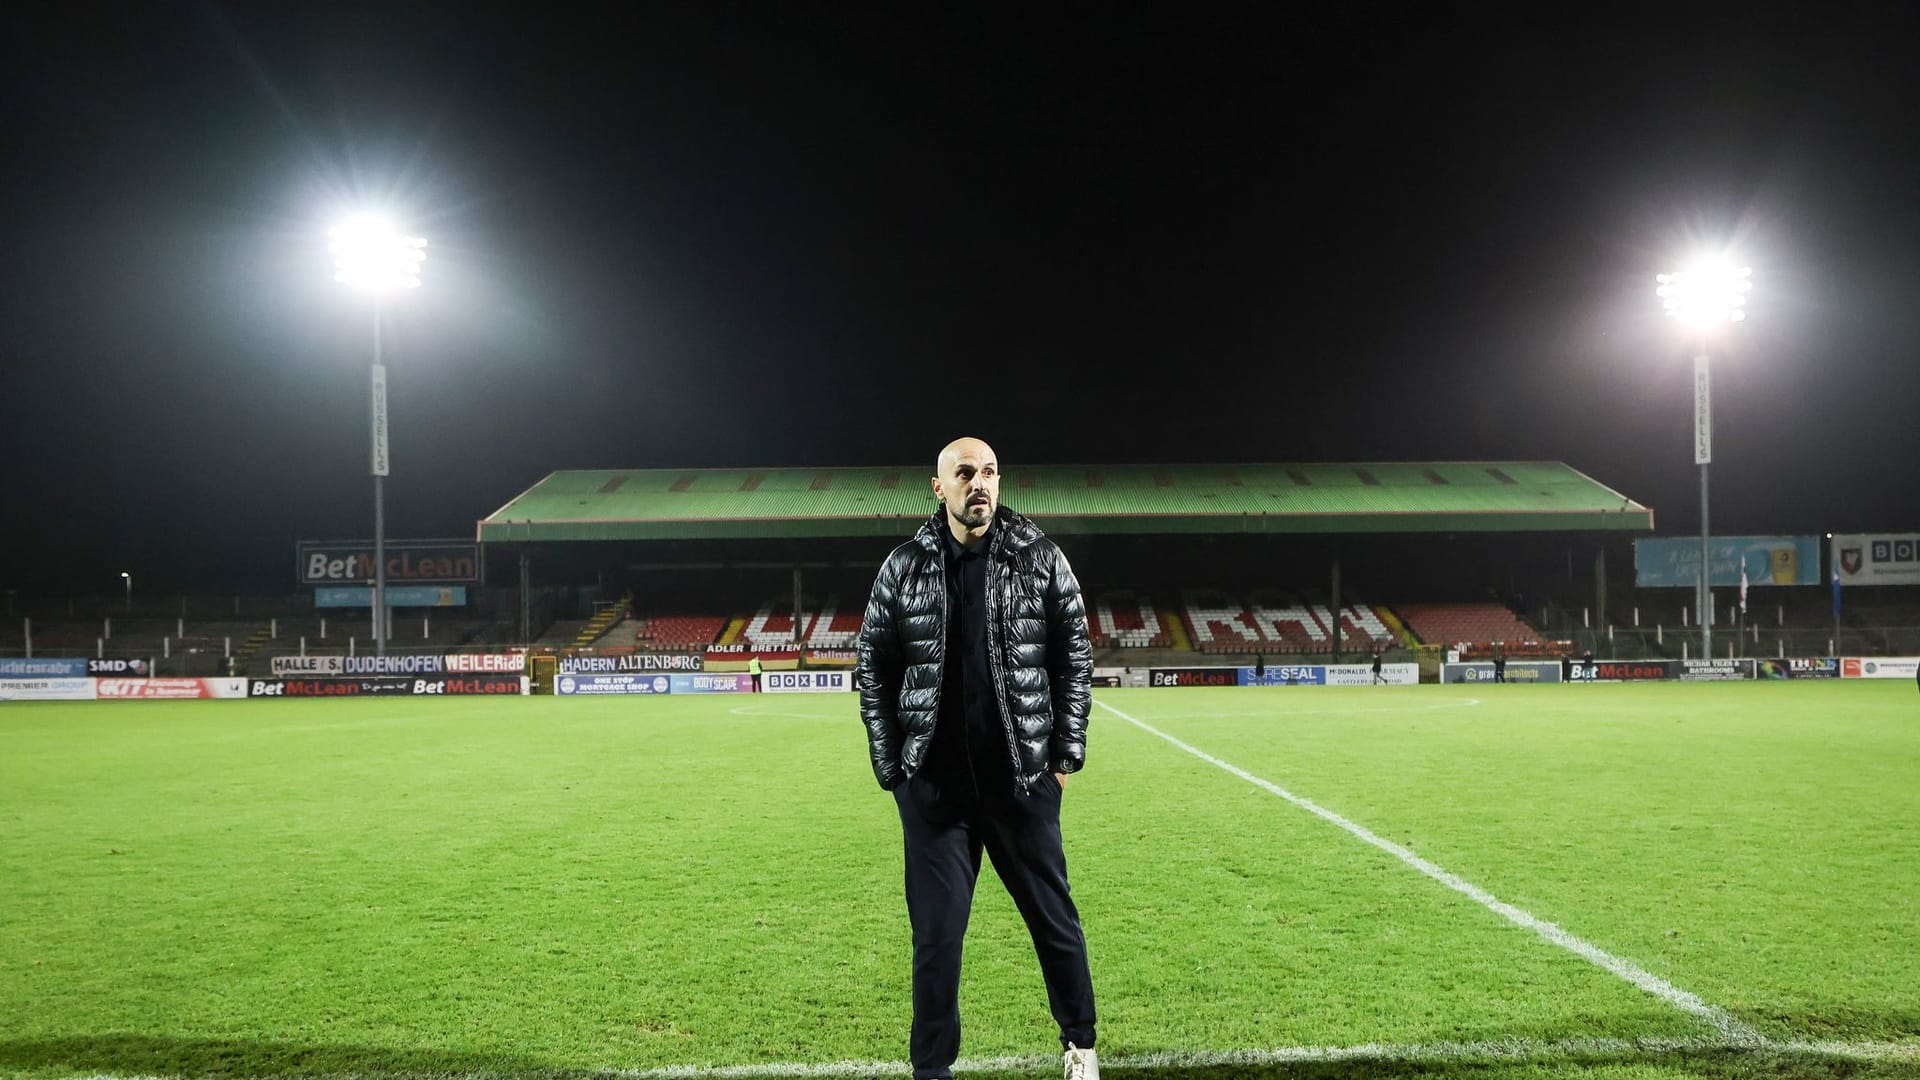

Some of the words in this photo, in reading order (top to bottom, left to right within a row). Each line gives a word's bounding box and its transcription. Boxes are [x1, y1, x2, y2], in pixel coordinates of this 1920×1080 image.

[707, 644, 744, 653] ADLER
[750, 643, 802, 653] BRETTEN
[813, 650, 858, 660] Sulinge
[89, 660, 127, 672] SMD
[274, 659, 317, 670] HALLE
[346, 656, 443, 673] DUDENHOFEN
[563, 658, 616, 672] HADERN
